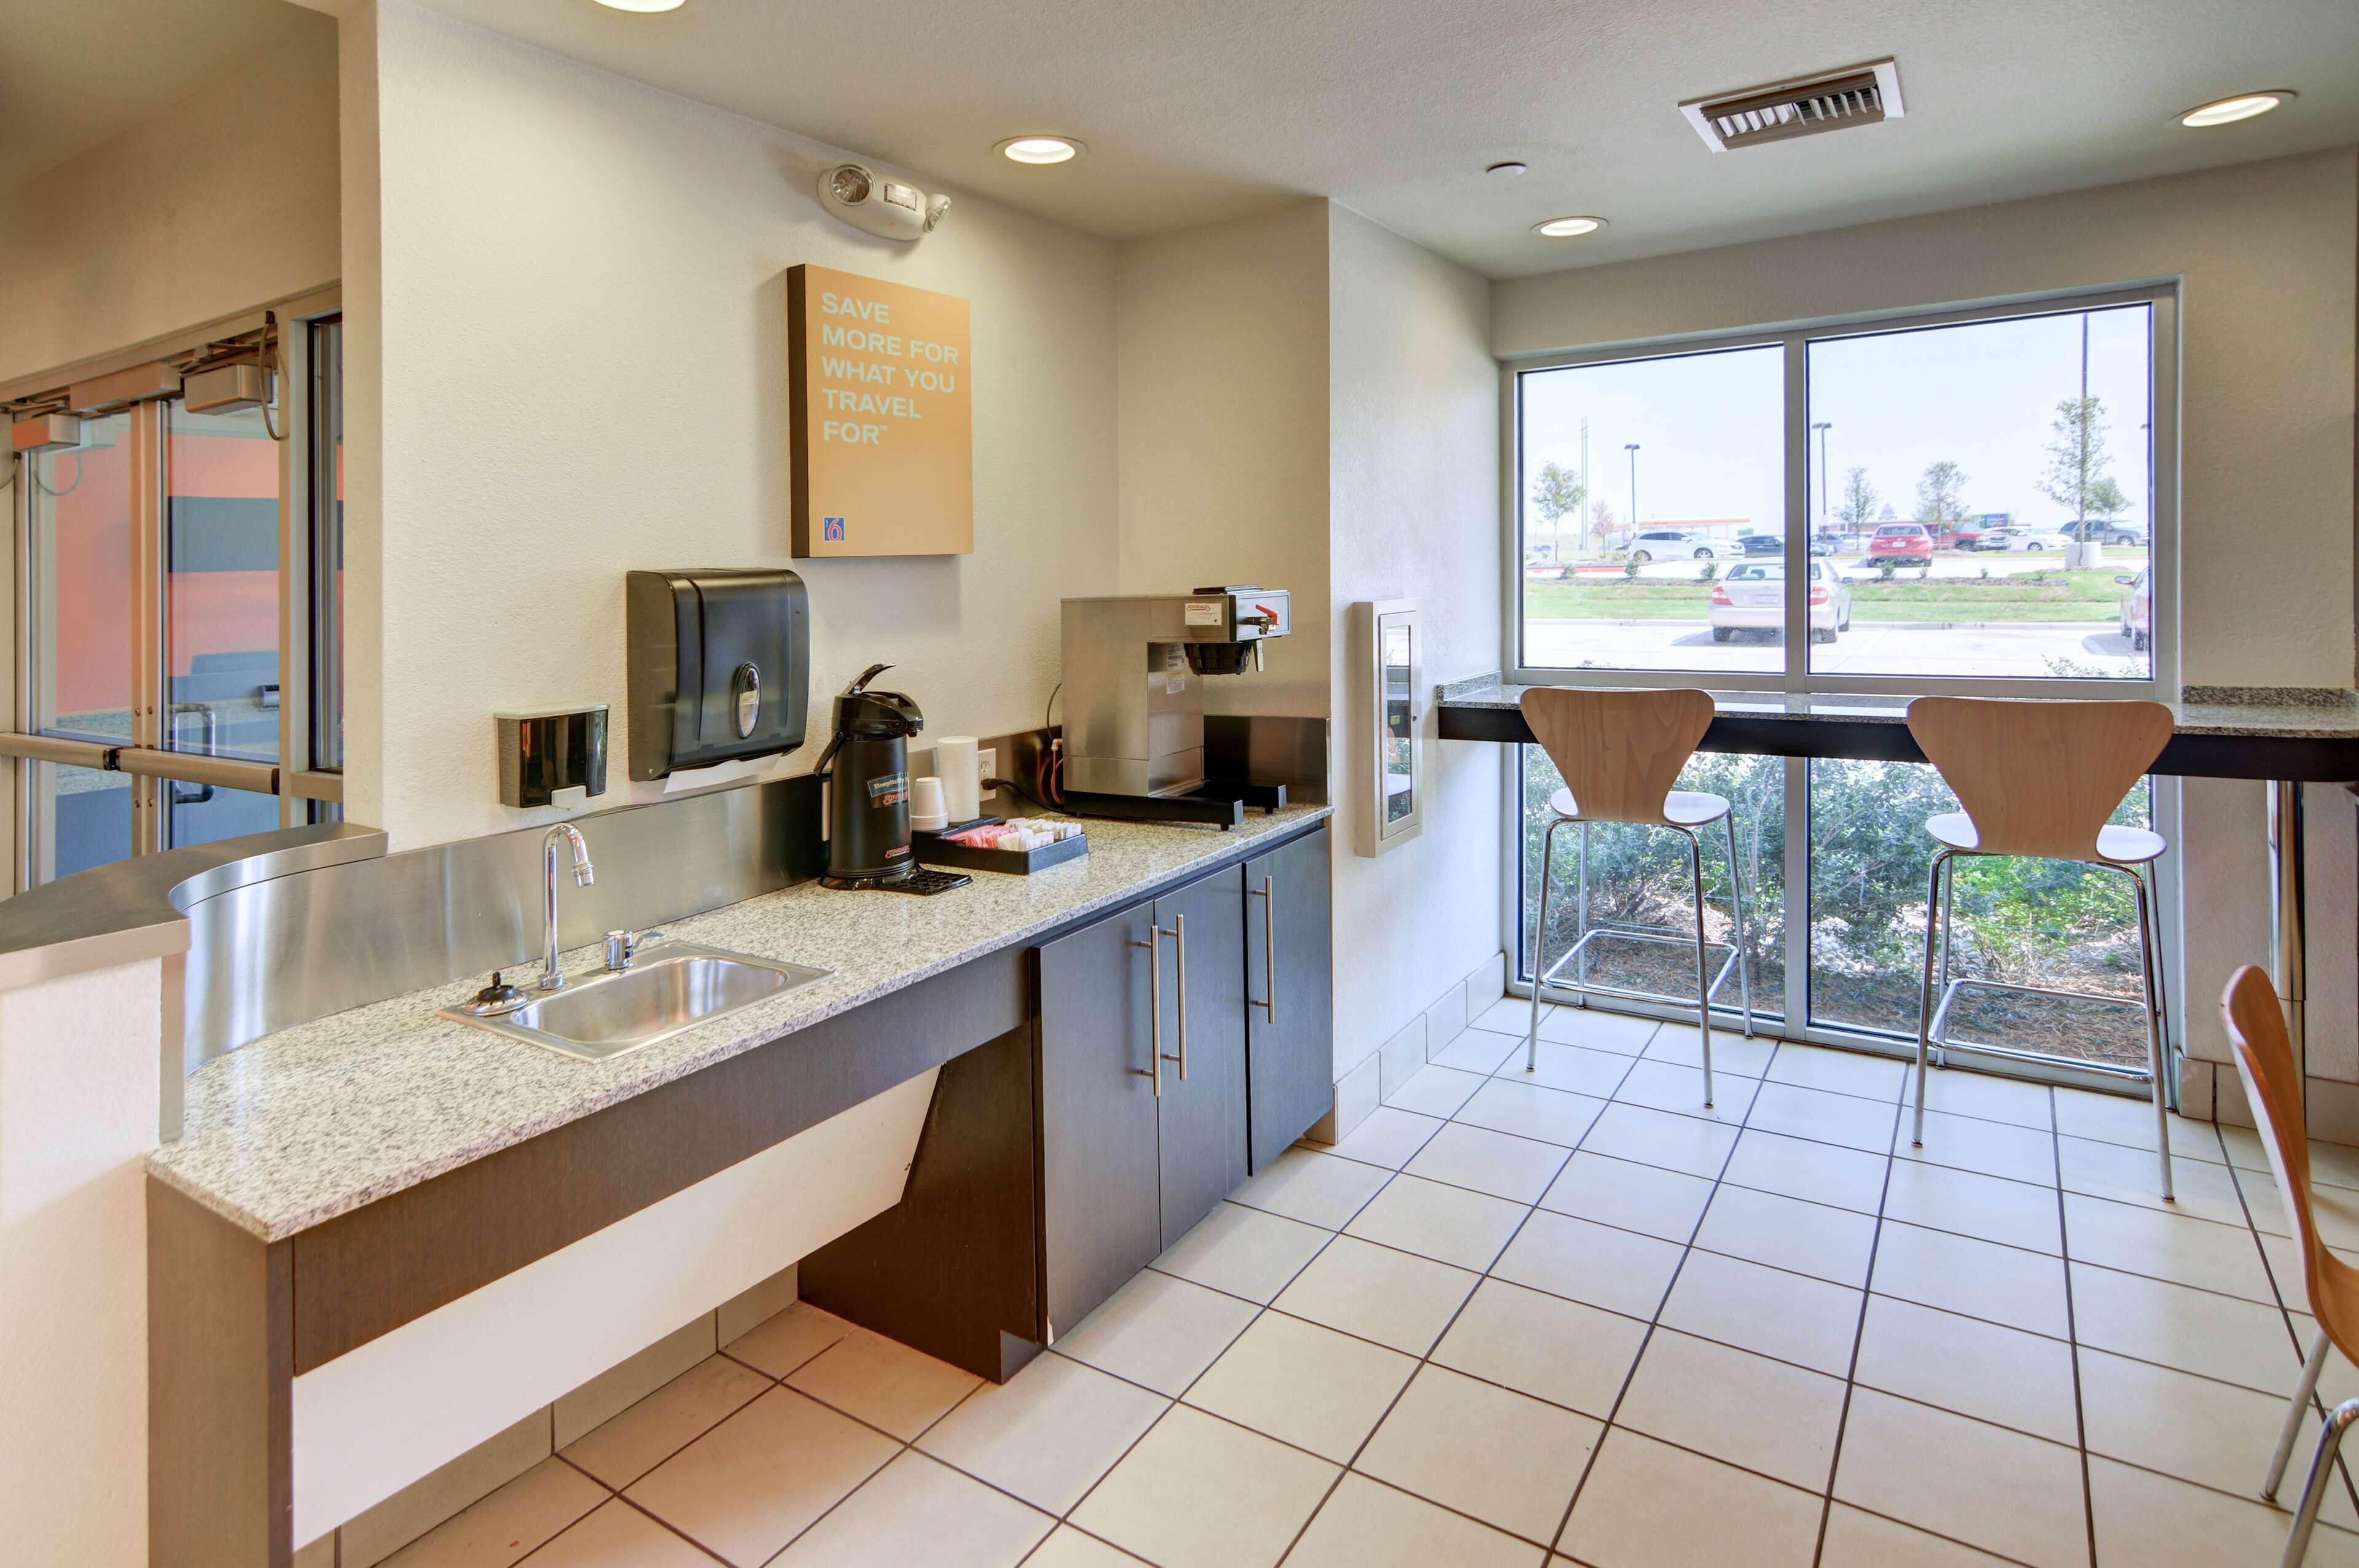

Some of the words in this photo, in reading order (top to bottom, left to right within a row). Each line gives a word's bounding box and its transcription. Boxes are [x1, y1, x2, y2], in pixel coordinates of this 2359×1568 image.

[821, 292, 890, 324] SAVE
[822, 324, 902, 357] MORE
[910, 339, 959, 365] FOR
[821, 356, 897, 385] WHAT
[904, 368, 955, 393] YOU
[822, 388, 922, 418] TRAVEL
